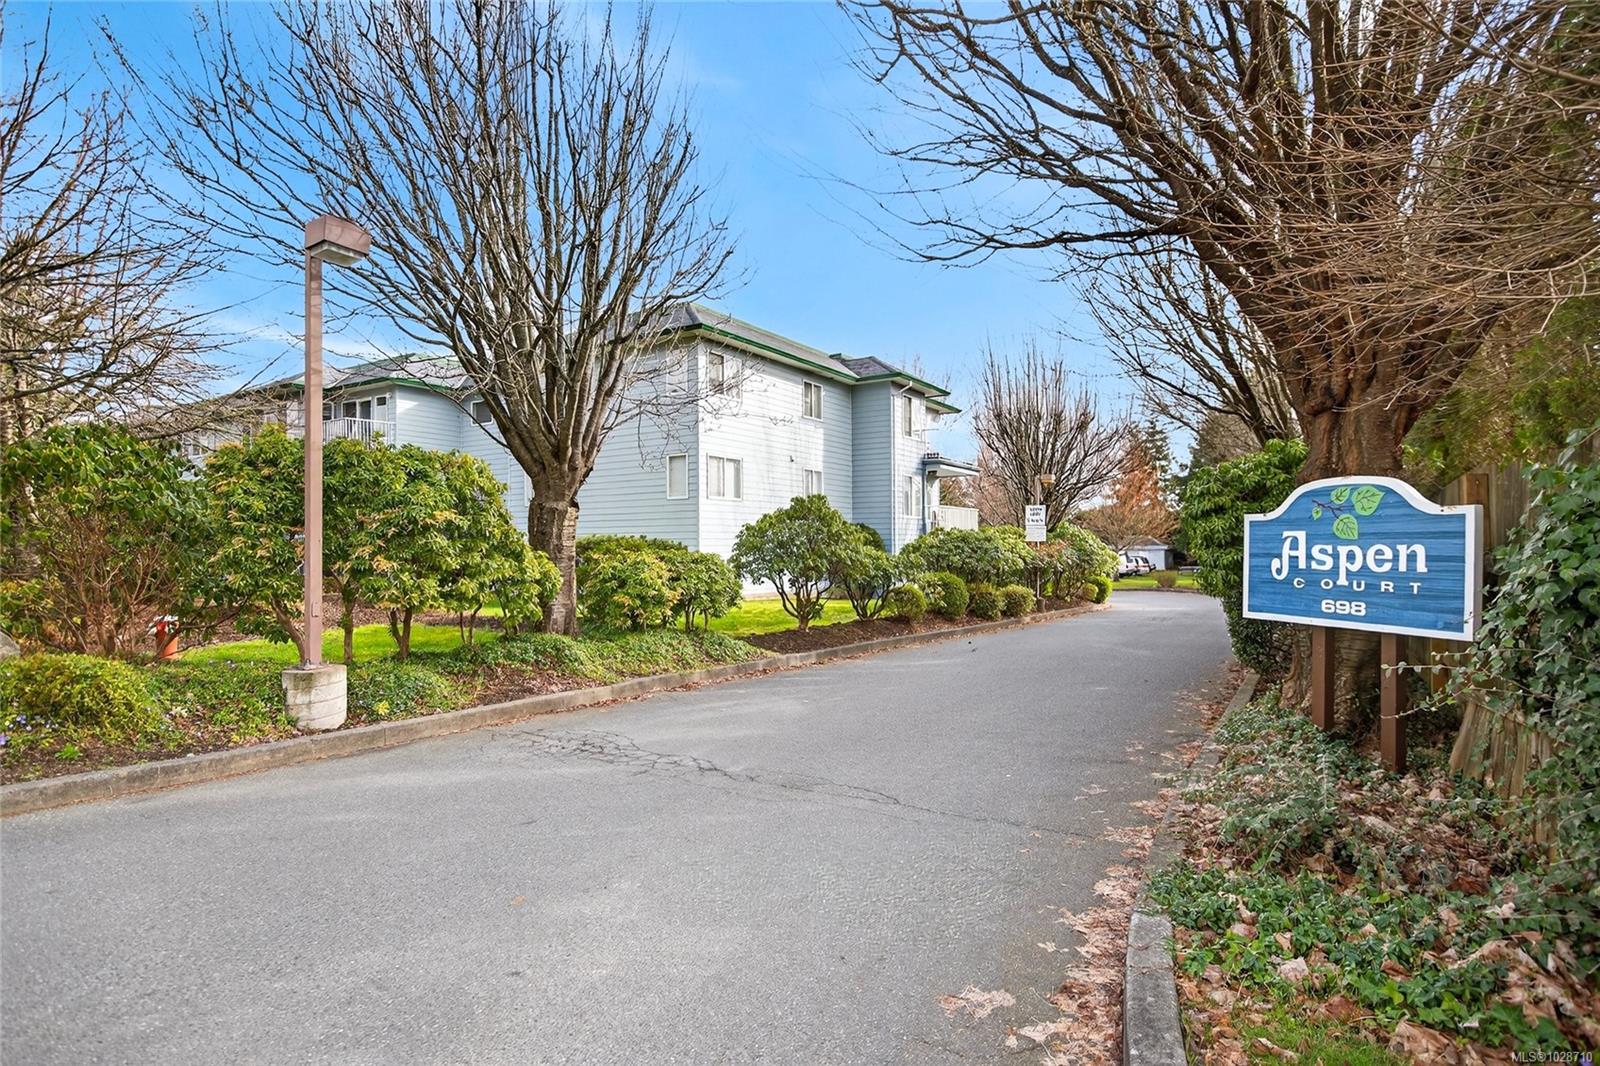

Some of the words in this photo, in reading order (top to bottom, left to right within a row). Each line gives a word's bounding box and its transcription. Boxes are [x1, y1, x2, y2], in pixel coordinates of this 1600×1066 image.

[1271, 530, 1428, 586] Aspen
[1293, 577, 1422, 595] COURT
[1321, 599, 1366, 616] 698
